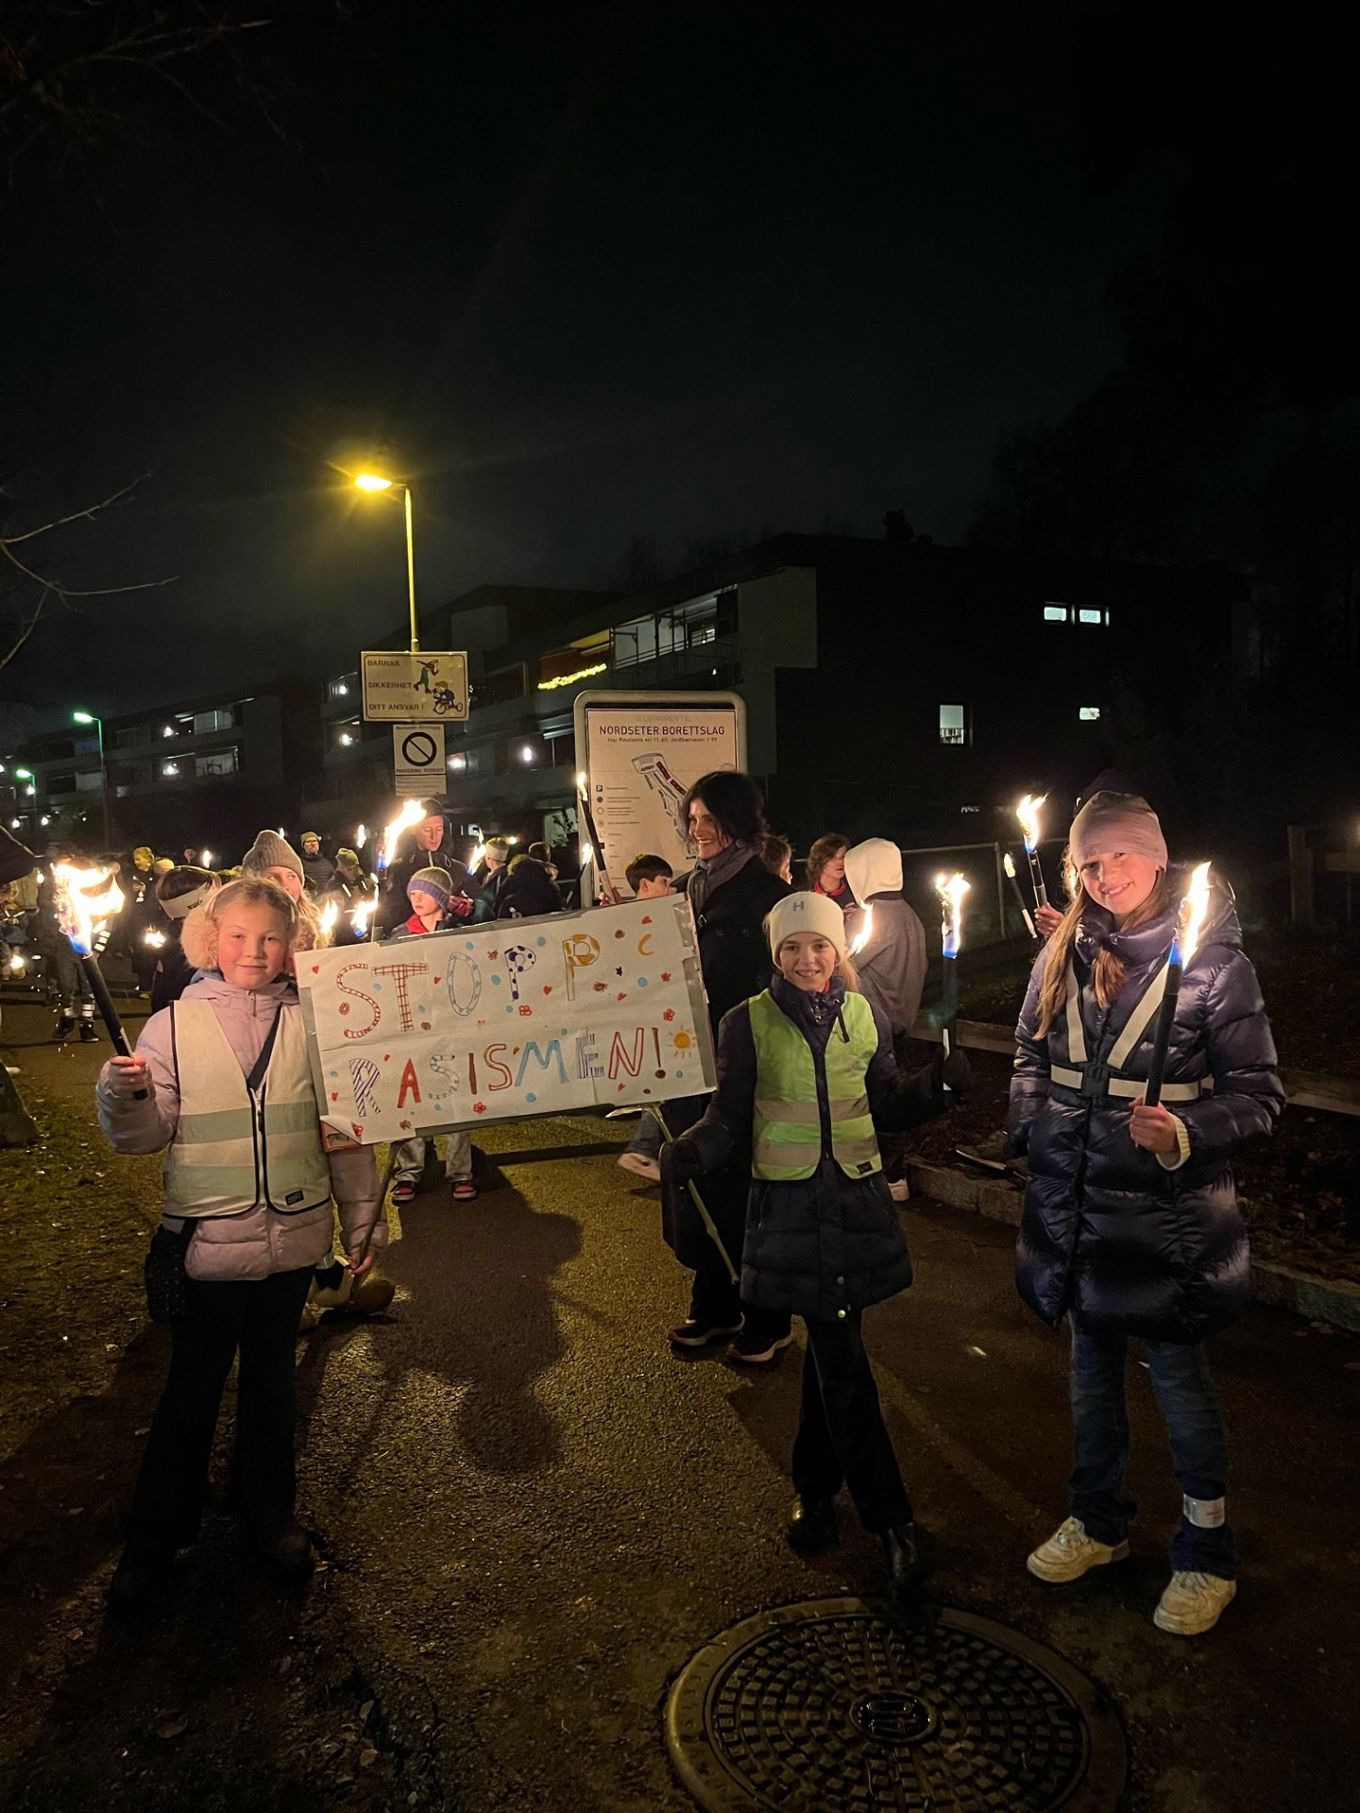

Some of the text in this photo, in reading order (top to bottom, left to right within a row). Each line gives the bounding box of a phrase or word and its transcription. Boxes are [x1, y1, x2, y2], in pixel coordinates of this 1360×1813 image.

[367, 659, 400, 667] BARNAS
[368, 681, 412, 689] SIKKERHET
[368, 703, 386, 711] DITT
[388, 703, 420, 711] ANSVAR
[599, 725, 725, 735] NORDSETER BORETTSLAG
[793, 901, 805, 912] H
[335, 932, 601, 1039] STOPP
[348, 1026, 667, 1117] RASISMEN!
